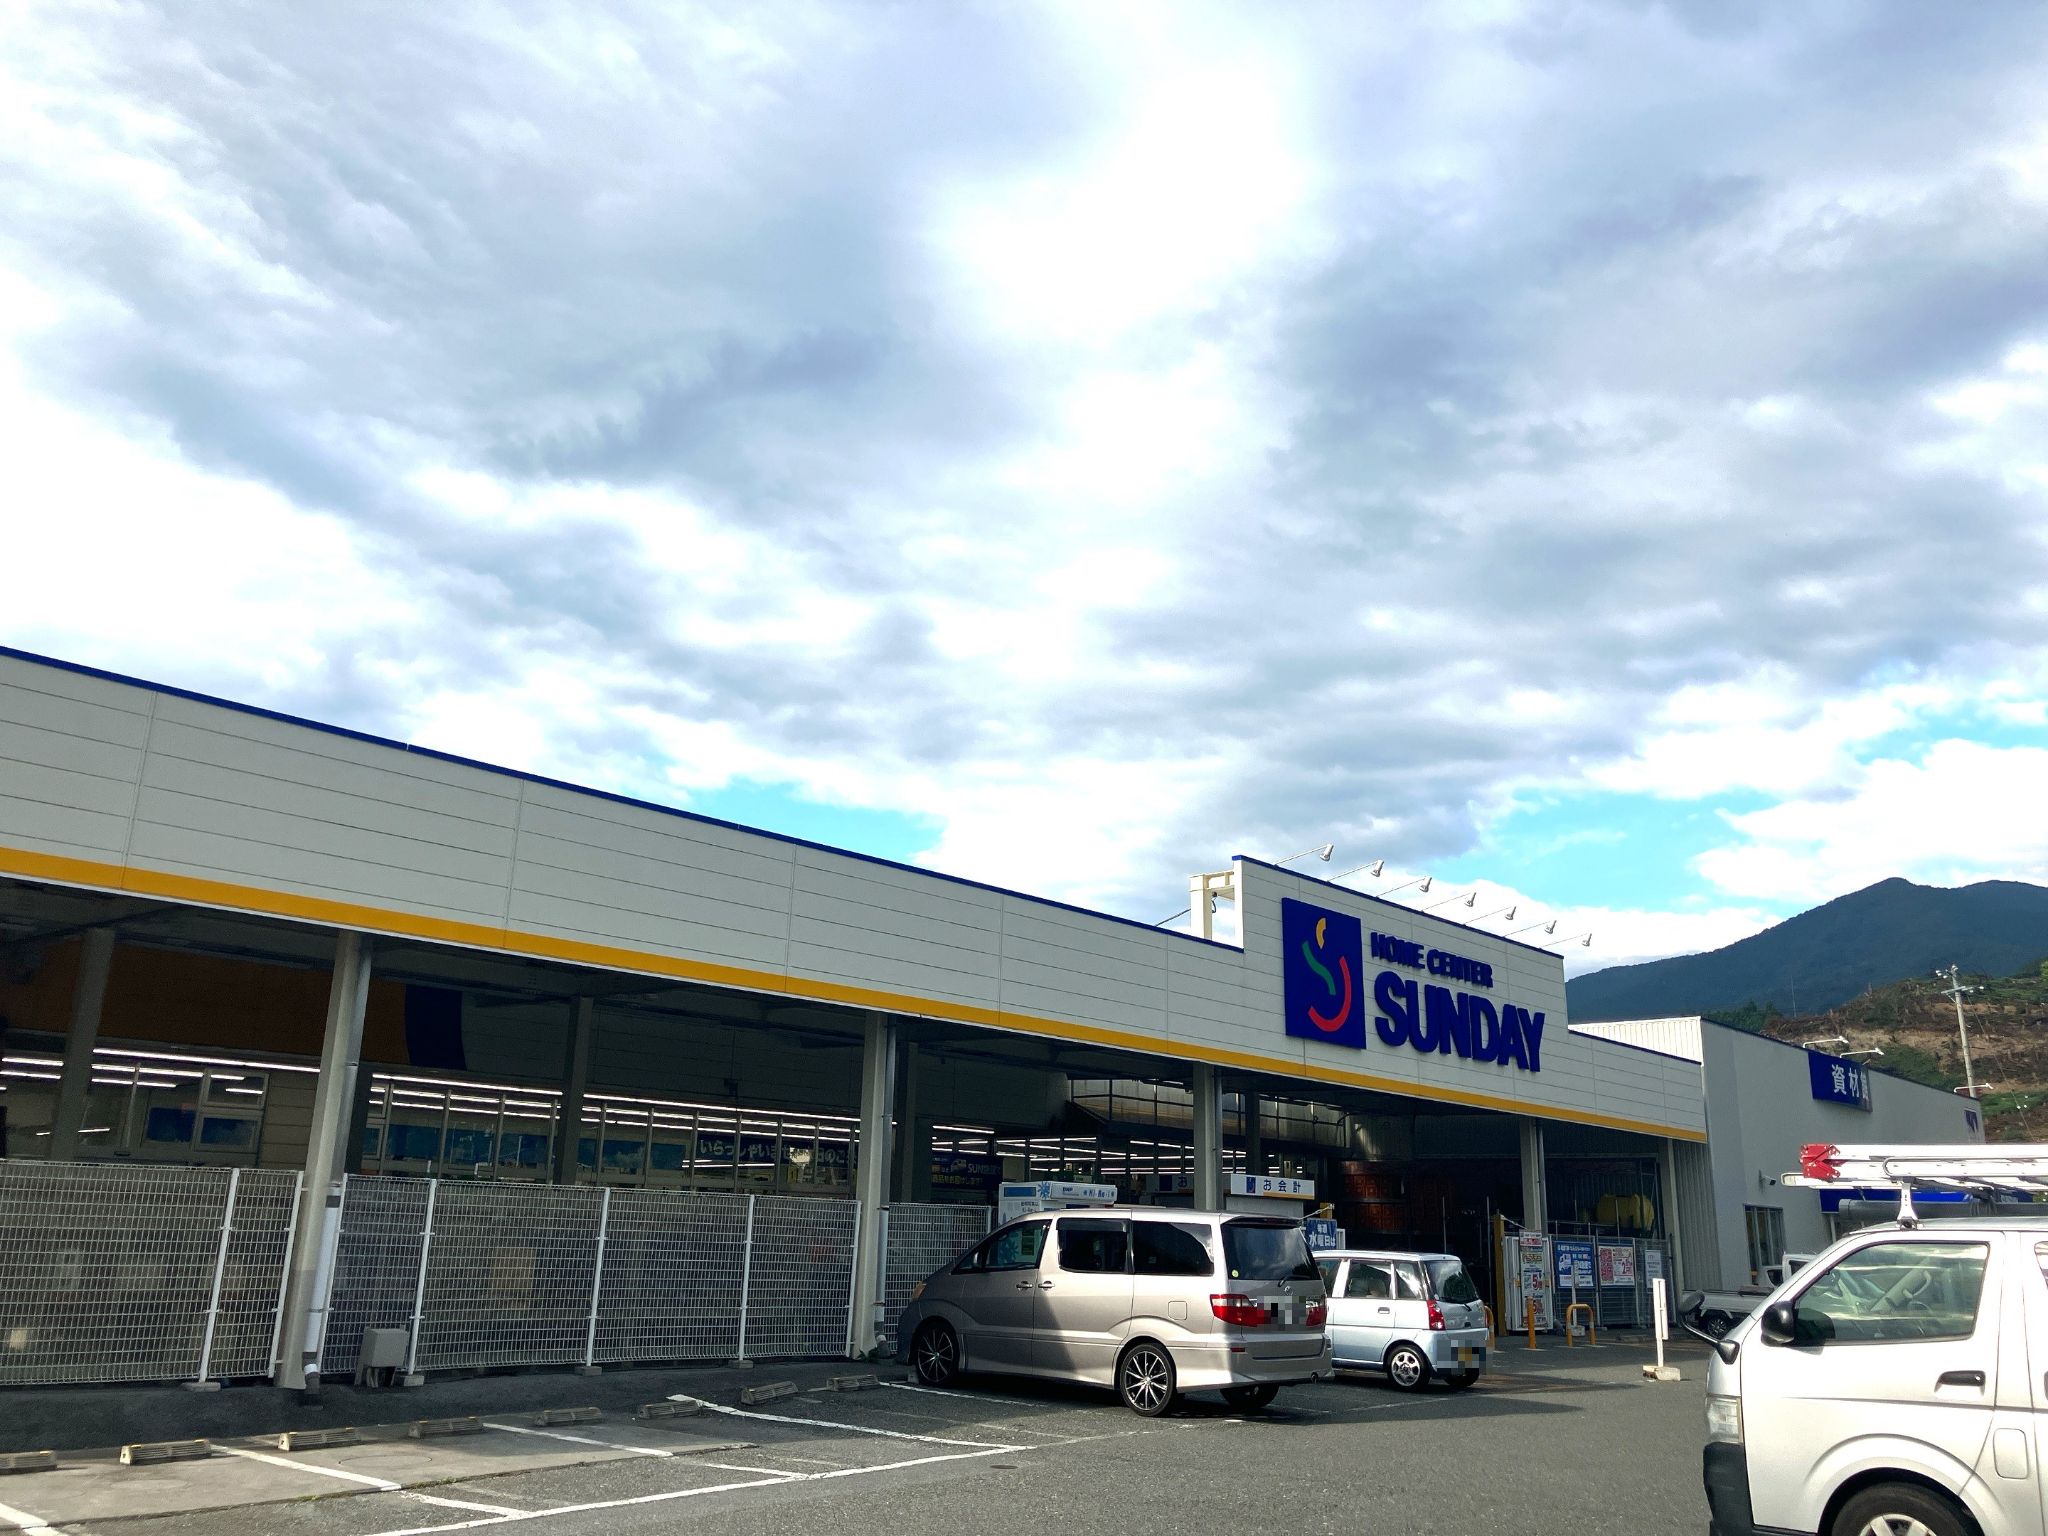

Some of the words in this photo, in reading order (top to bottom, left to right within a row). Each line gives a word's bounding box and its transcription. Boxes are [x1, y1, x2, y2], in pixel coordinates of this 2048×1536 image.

[1371, 932, 1425, 969] HOME
[1427, 949, 1493, 988] CENTER
[1374, 971, 1545, 1072] SUNDAY
[1263, 1179, 1301, 1194] お会計
